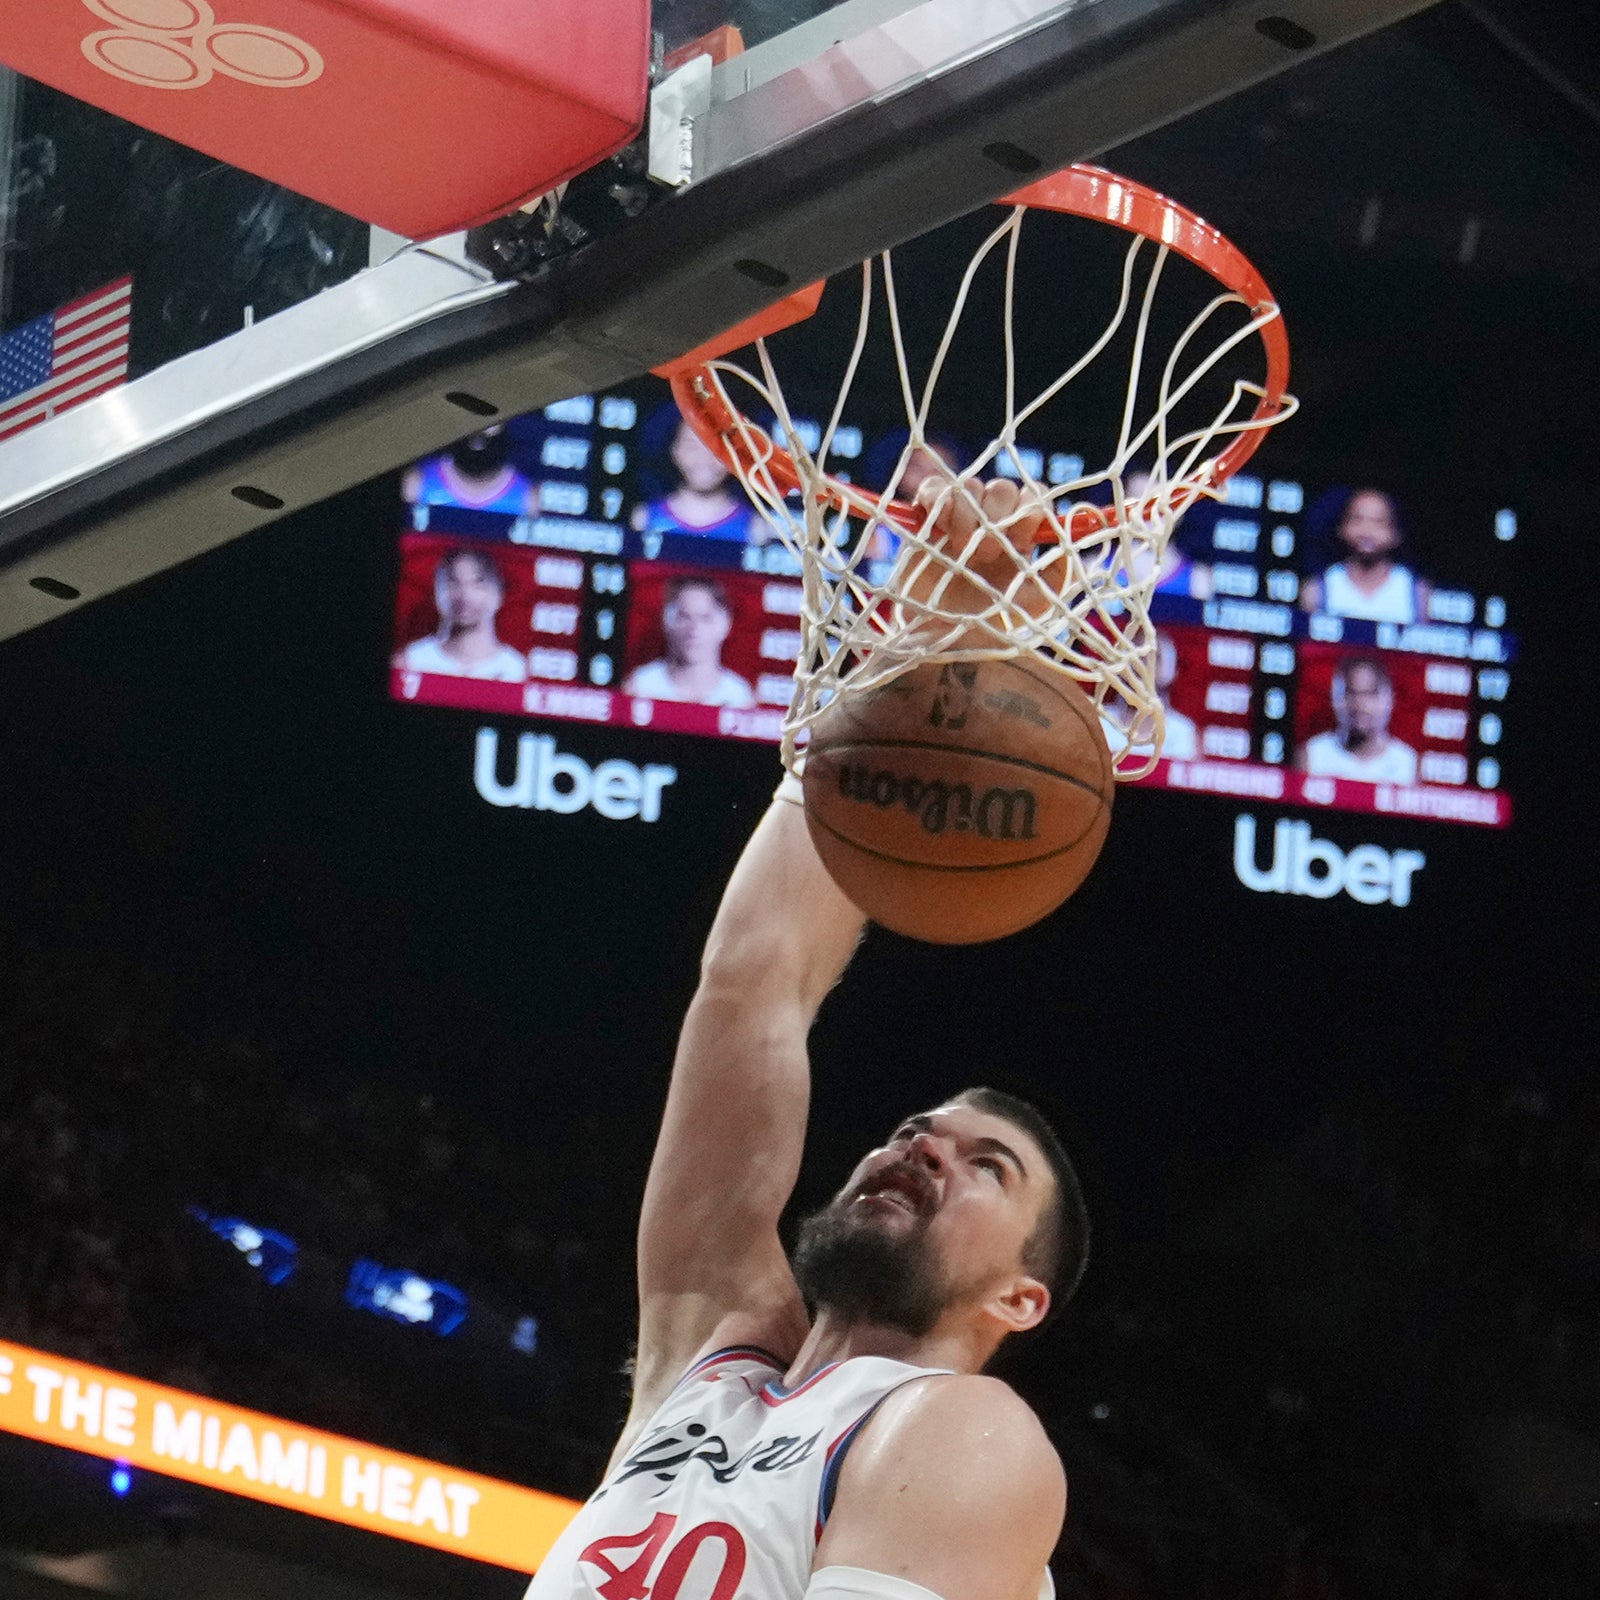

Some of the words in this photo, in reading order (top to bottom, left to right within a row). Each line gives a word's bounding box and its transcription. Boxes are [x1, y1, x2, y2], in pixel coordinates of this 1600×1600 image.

[474, 727, 677, 823] Uber
[839, 762, 1038, 841] Wilson
[1233, 812, 1426, 907] Uber
[25, 1367, 136, 1447] THE
[152, 1401, 326, 1499] MIAMI
[341, 1456, 480, 1538] HEAT
